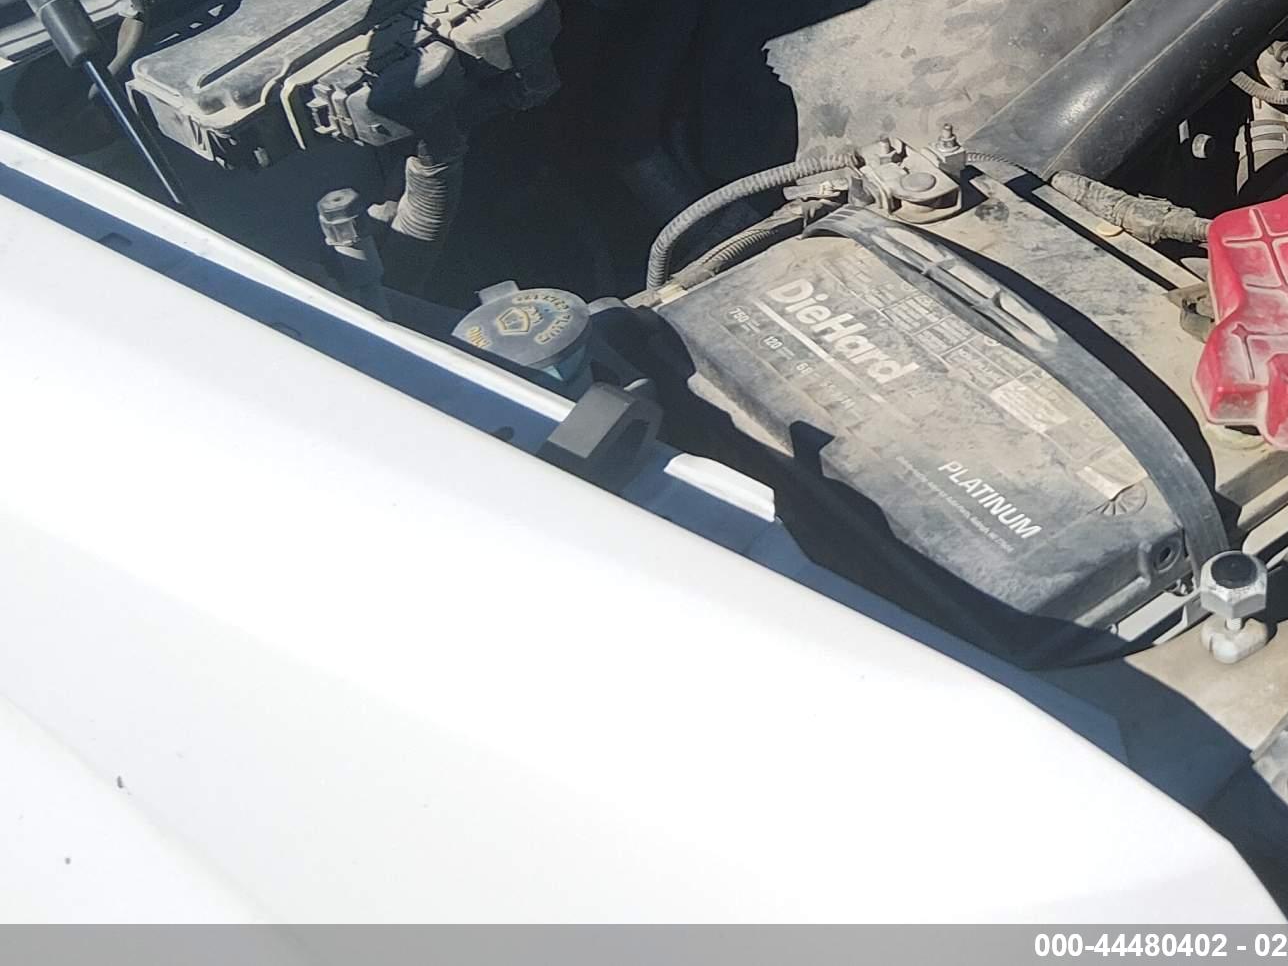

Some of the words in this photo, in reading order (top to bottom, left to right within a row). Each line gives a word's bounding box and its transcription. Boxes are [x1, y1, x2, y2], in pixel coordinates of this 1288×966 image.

[763, 335, 784, 349] 120
[766, 278, 920, 384] DieHard
[937, 460, 1043, 539] PLATINUM
